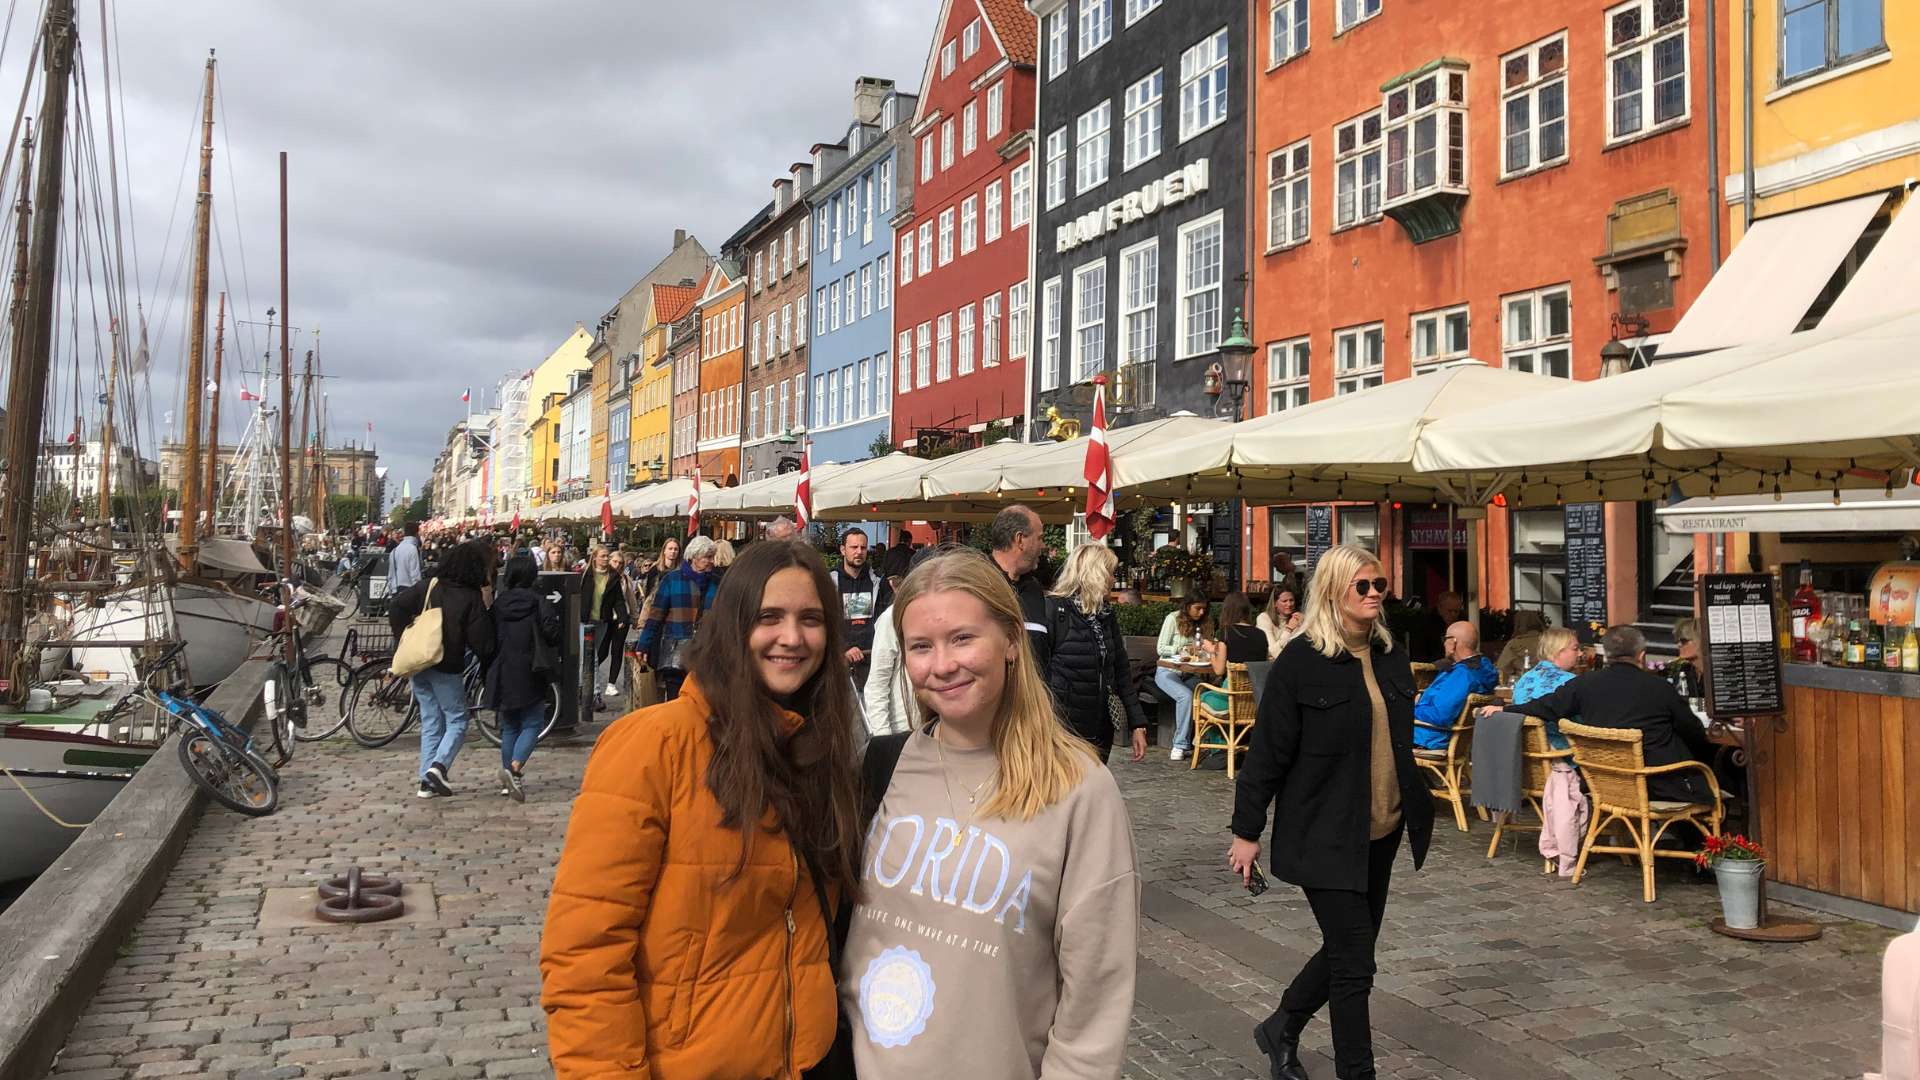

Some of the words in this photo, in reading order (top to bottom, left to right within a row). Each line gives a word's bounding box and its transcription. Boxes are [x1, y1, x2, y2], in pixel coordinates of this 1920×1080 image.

[1056, 158, 1209, 253] HAVFRUEN
[920, 435, 941, 454] 37
[1682, 517, 1746, 529] RESTAURANT
[1455, 530, 1466, 544] 41
[867, 909, 889, 923] LIFE
[894, 916, 912, 932] ONE
[918, 924, 943, 942] WAVE
[946, 934, 958, 946] AT
[961, 937, 968, 949] A
[973, 940, 1000, 957] TIME
